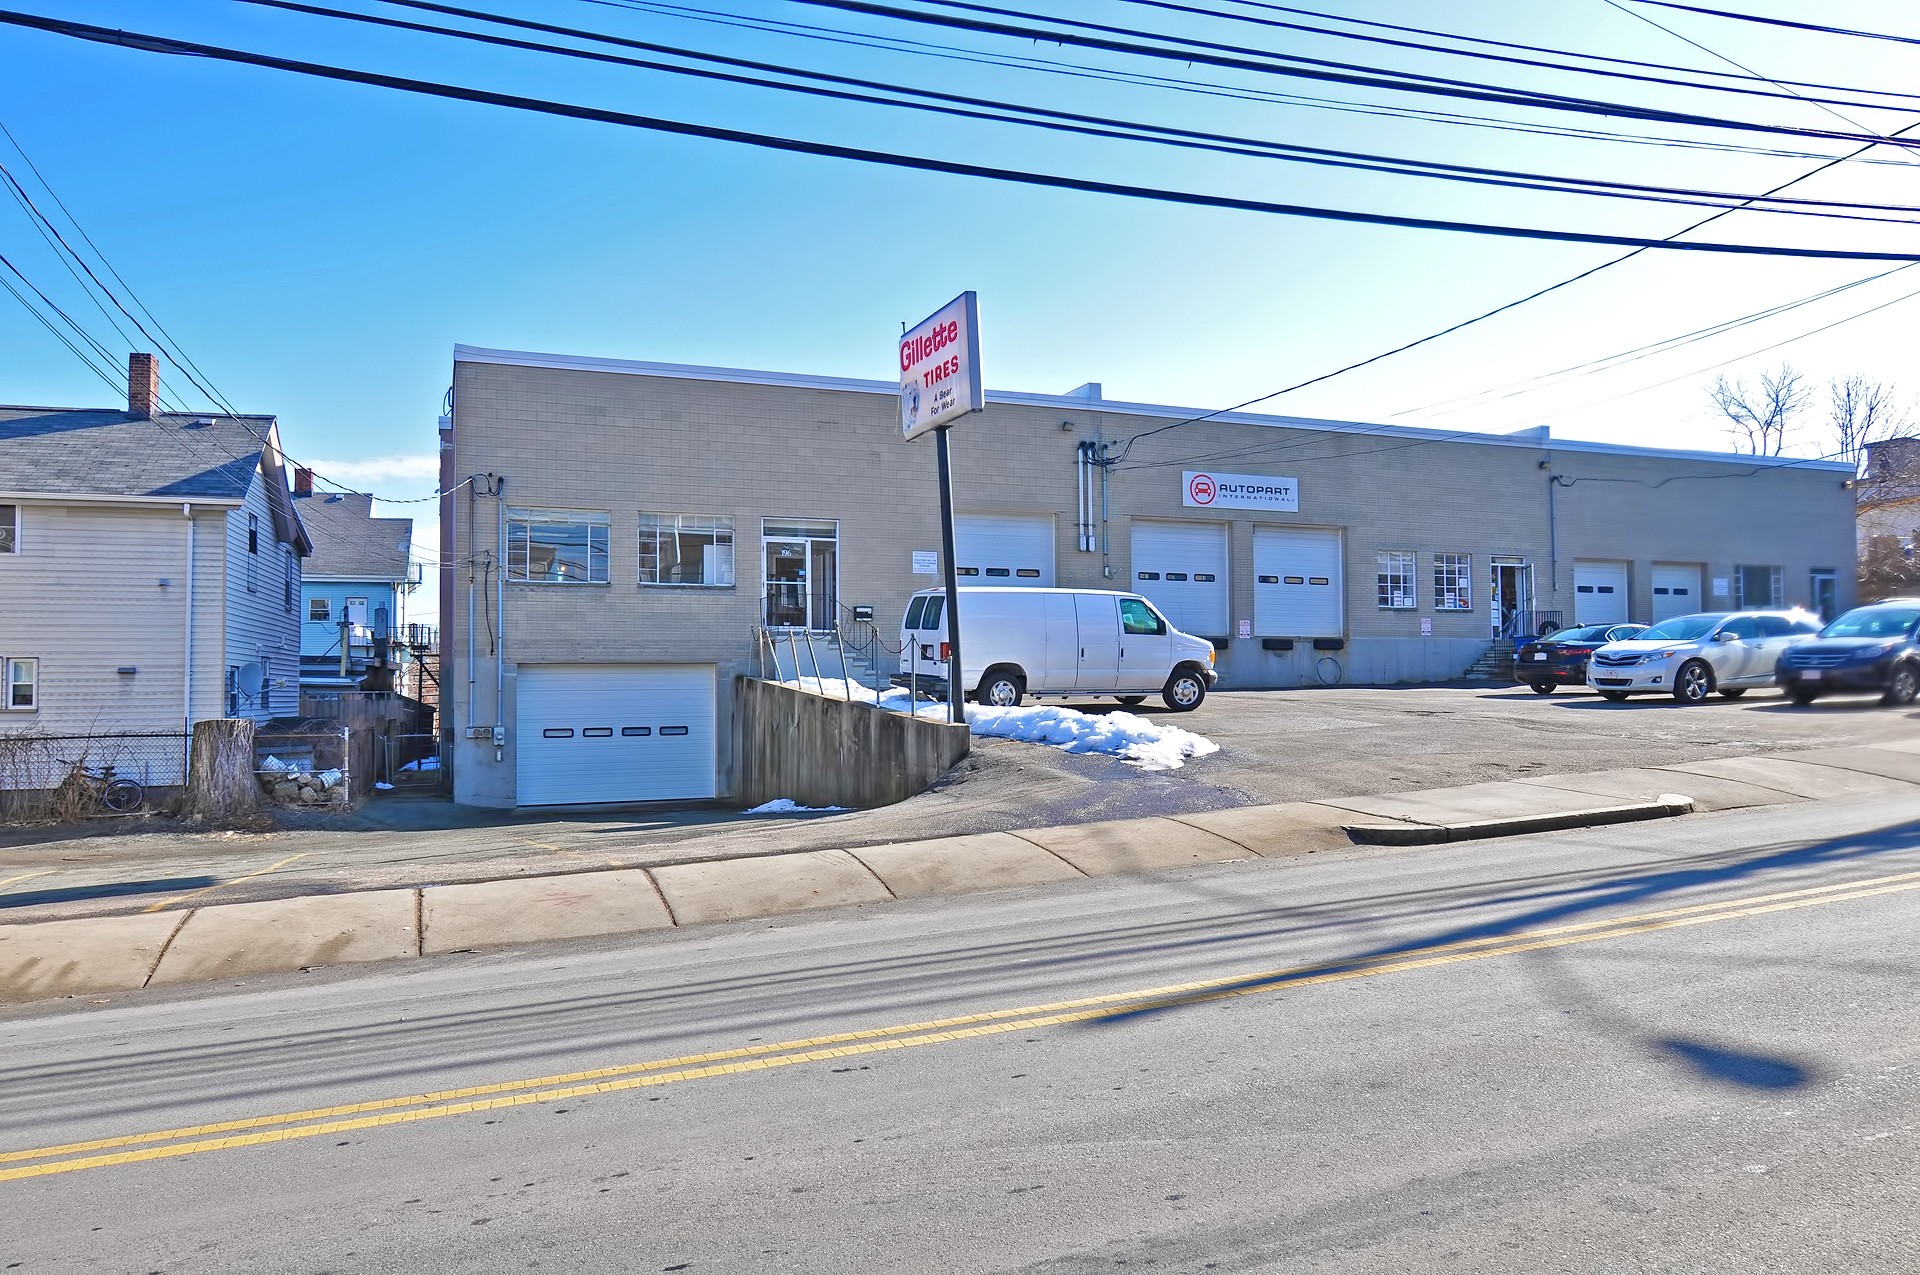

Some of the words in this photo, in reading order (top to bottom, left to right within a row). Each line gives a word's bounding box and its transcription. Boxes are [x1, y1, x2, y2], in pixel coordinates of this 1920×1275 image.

[901, 320, 958, 372] Gillette
[924, 355, 959, 389] TIRES
[934, 393, 938, 403] A
[939, 387, 952, 400] Bear
[930, 406, 940, 416] For
[941, 398, 956, 411] Wear
[1219, 484, 1290, 495] AUTOPART
[1219, 494, 1290, 502] INTERNATIONAL
[781, 549, 792, 557] 196
